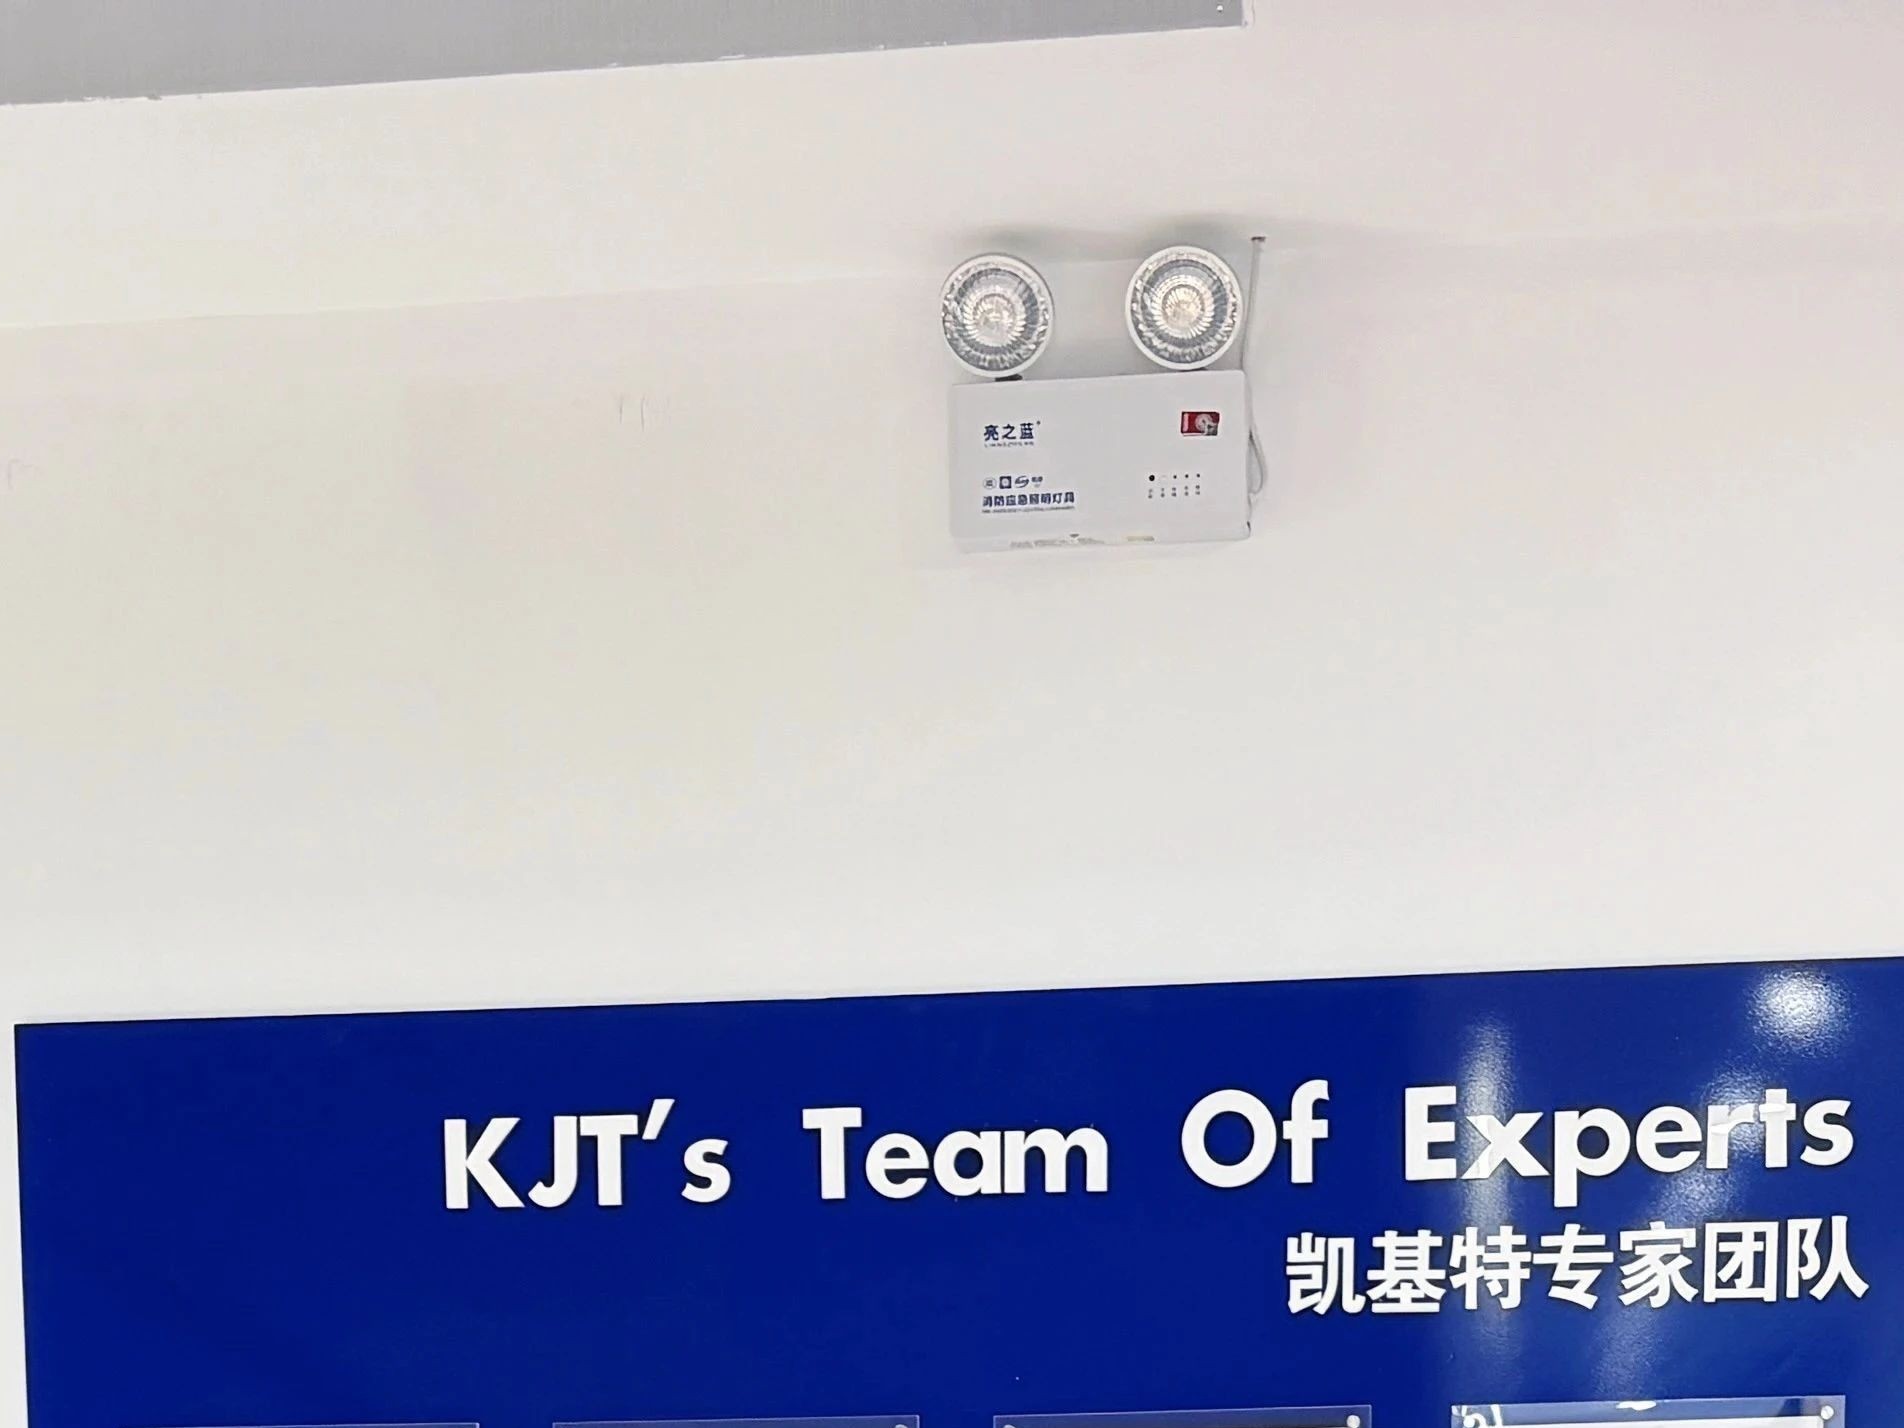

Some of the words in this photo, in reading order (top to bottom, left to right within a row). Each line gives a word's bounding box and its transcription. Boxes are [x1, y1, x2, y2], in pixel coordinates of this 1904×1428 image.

[984, 423, 1034, 441] 亮之蓝
[443, 1098, 730, 1210] KJT's
[802, 1107, 1108, 1199] Team
[1180, 1080, 1329, 1188] Of
[1405, 1083, 1853, 1208] Experts
[1285, 1216, 1869, 1315] 凯基特专家团队
